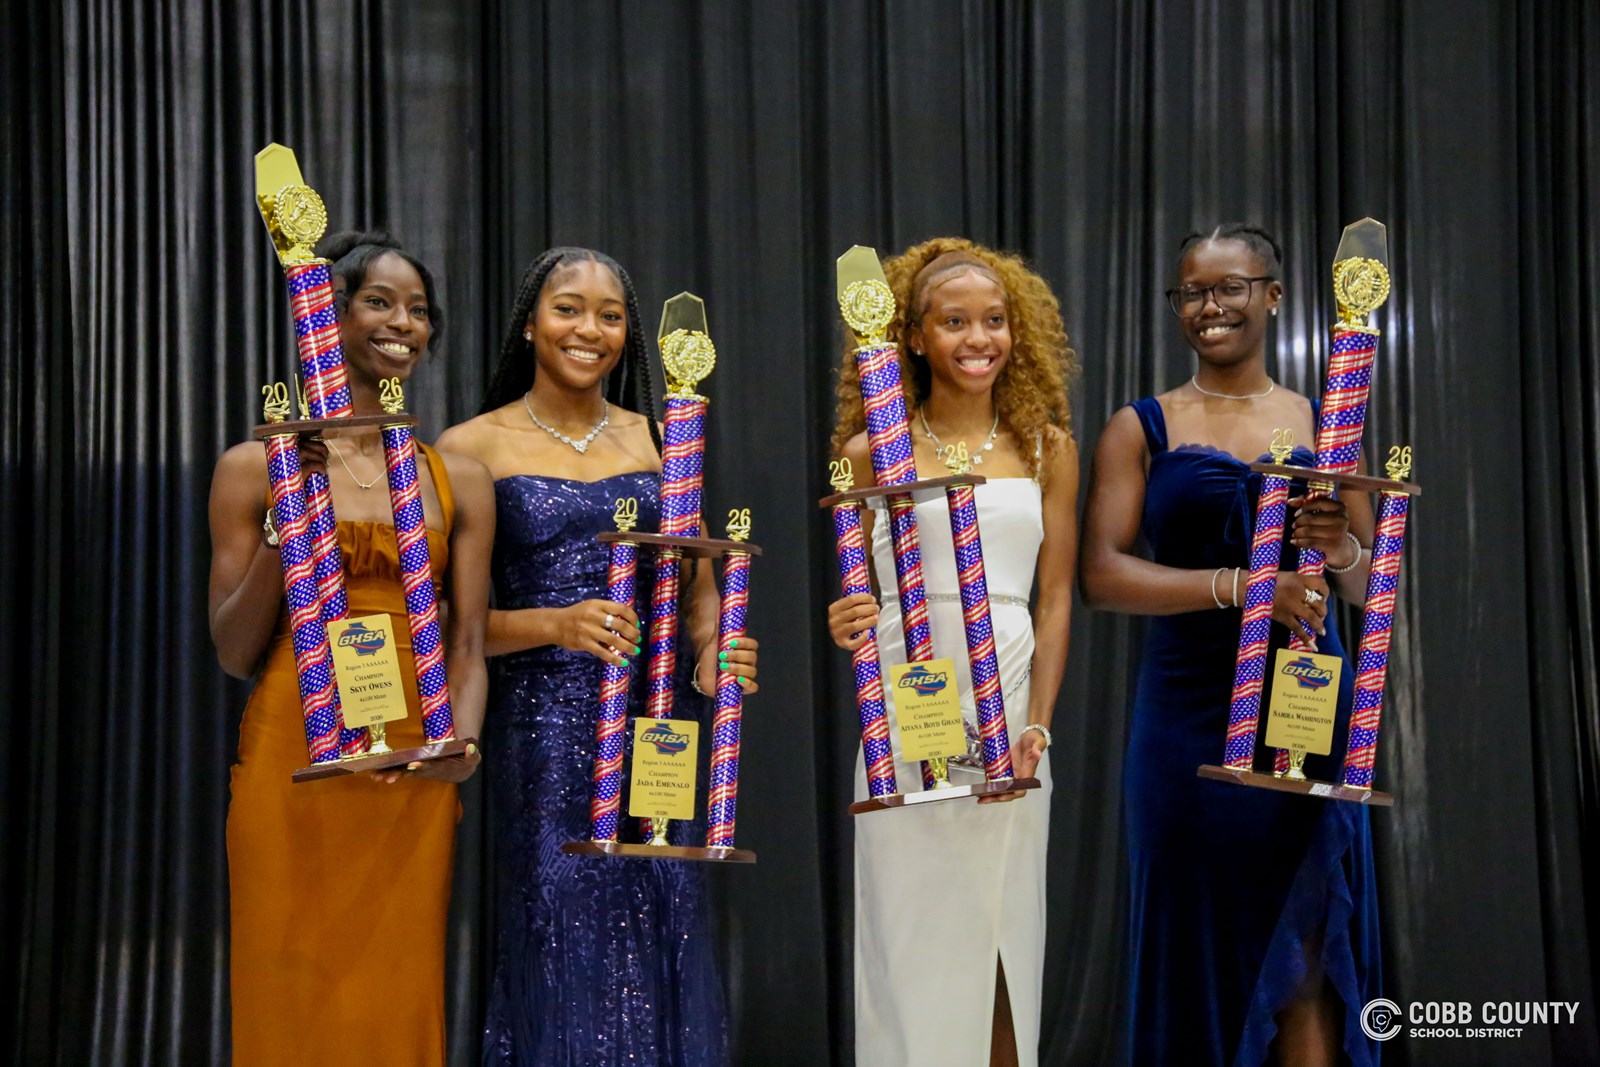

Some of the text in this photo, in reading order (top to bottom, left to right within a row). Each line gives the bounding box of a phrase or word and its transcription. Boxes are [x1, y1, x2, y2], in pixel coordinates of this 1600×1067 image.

[262, 377, 403, 406] 20 26
[1270, 428, 1412, 466] 20 26
[829, 441, 968, 481] 20 26
[614, 497, 751, 528] 20 26
[338, 629, 386, 647] GHSA
[899, 672, 948, 688] GHSA
[1282, 665, 1333, 680] GHSA
[350, 680, 392, 694] SKYY OWENS
[641, 733, 690, 743] GHSA
